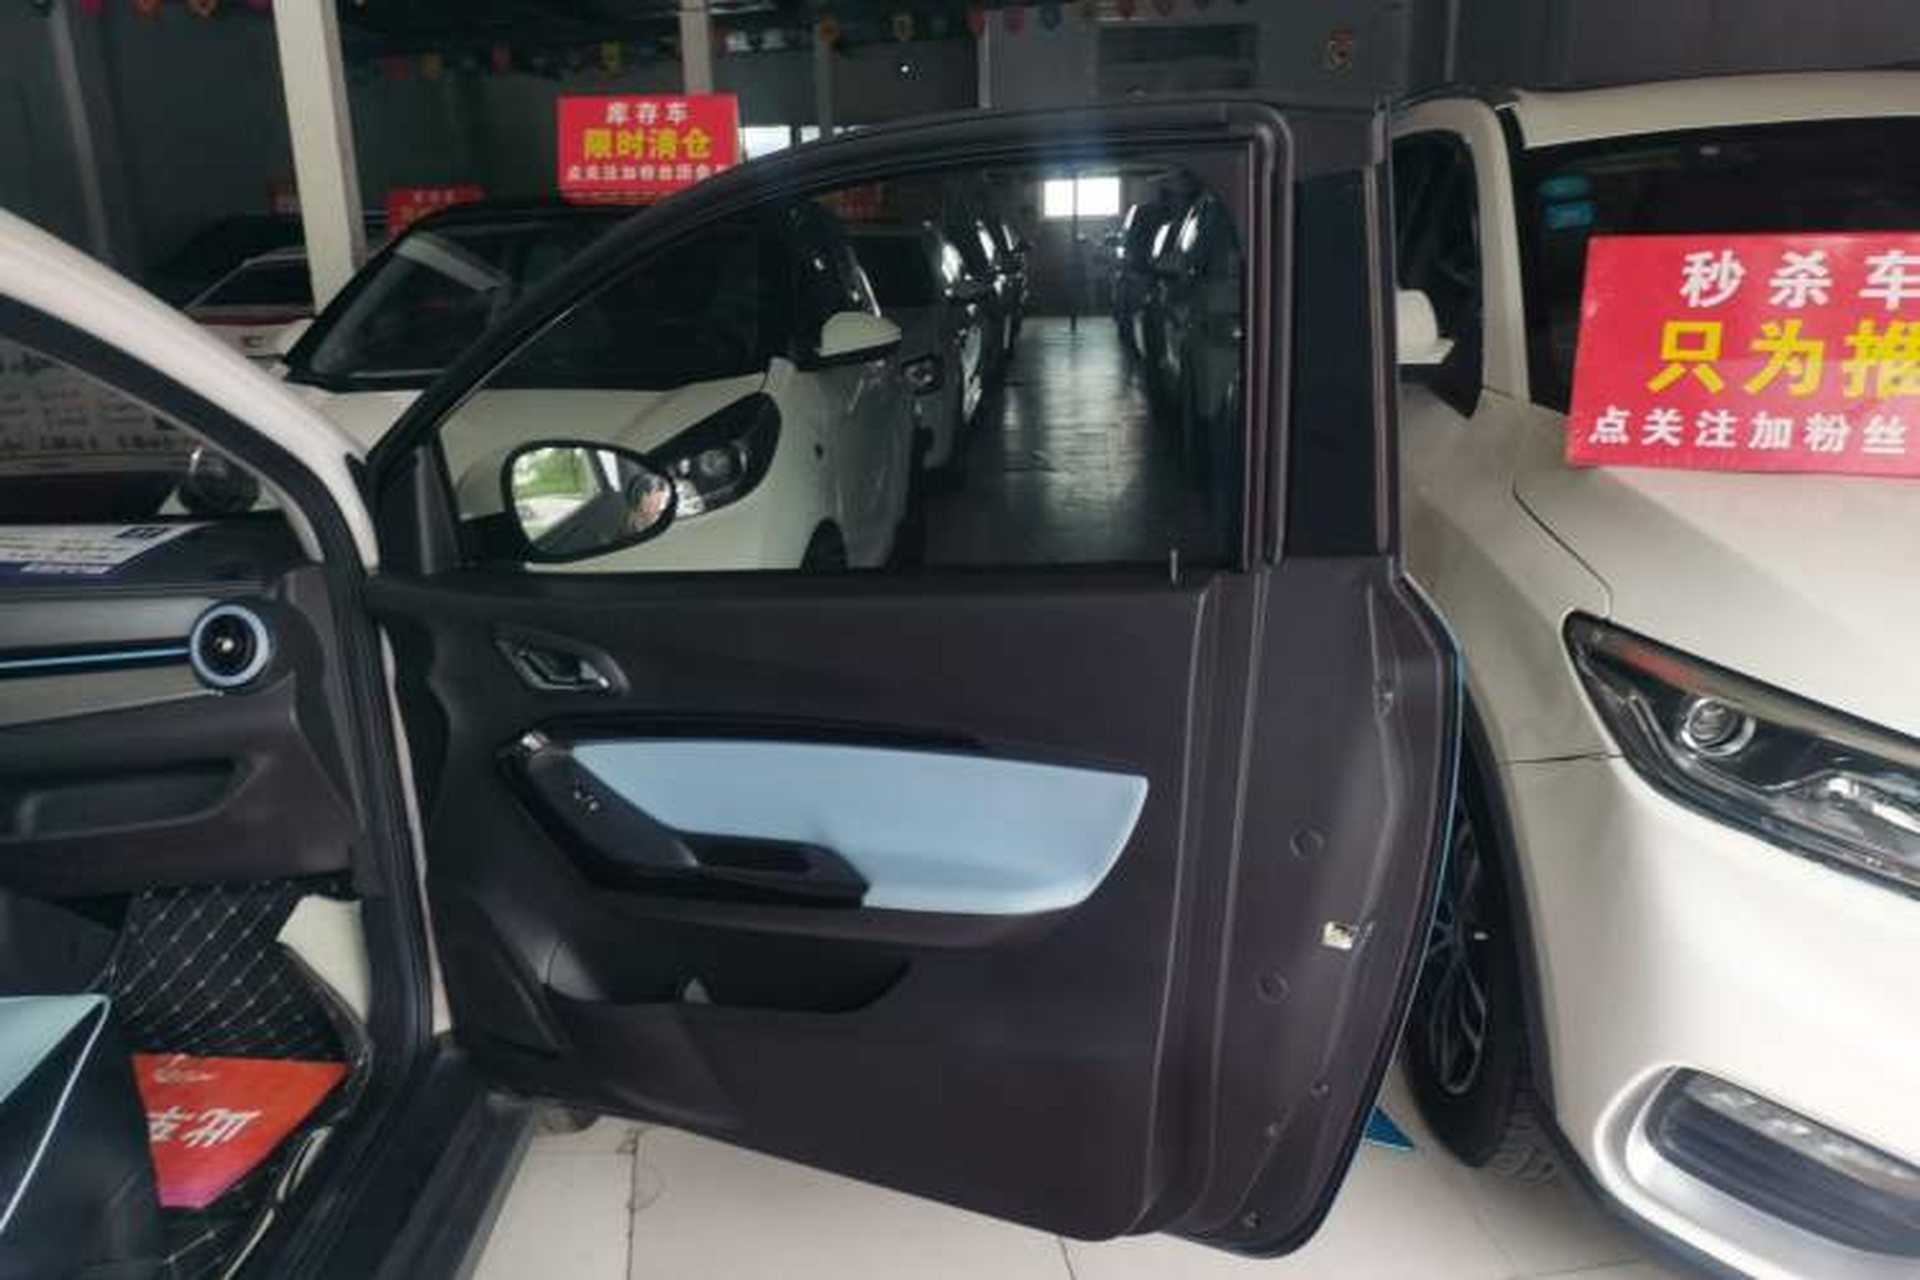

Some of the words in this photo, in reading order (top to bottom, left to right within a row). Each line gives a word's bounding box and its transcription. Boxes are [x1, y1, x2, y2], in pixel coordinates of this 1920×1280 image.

[1679, 249, 1920, 310] 秒杀车
[1588, 405, 1906, 454] 点关注加粉丝
